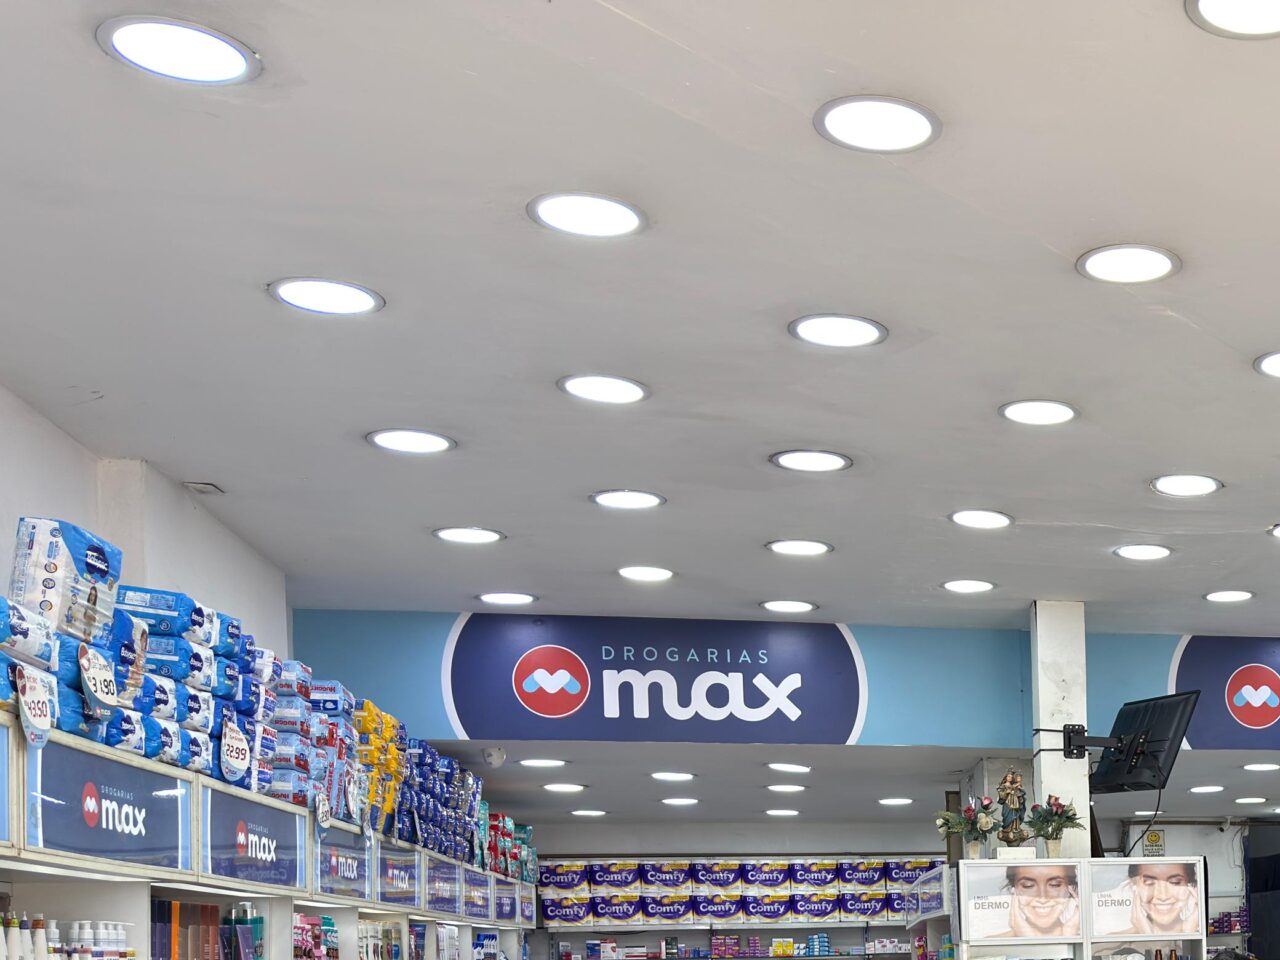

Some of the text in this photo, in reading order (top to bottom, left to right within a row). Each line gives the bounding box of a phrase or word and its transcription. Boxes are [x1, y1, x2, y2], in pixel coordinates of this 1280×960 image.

[602, 646, 768, 663] DROGARIAS
[603, 669, 801, 721] max
[101, 786, 133, 800] DROGARIAS
[102, 798, 145, 836] max
[248, 834, 276, 862] max
[339, 856, 357, 879] max
[393, 867, 409, 889] max
[542, 873, 580, 883] Comfy
[596, 872, 633, 882] Comfy
[648, 871, 685, 881] Comfy
[699, 871, 734, 881] Comfy
[748, 872, 784, 882] Comfy
[797, 871, 832, 881] Comfy
[974, 901, 1009, 910] DERMO
[1098, 899, 1132, 908] DERMO
